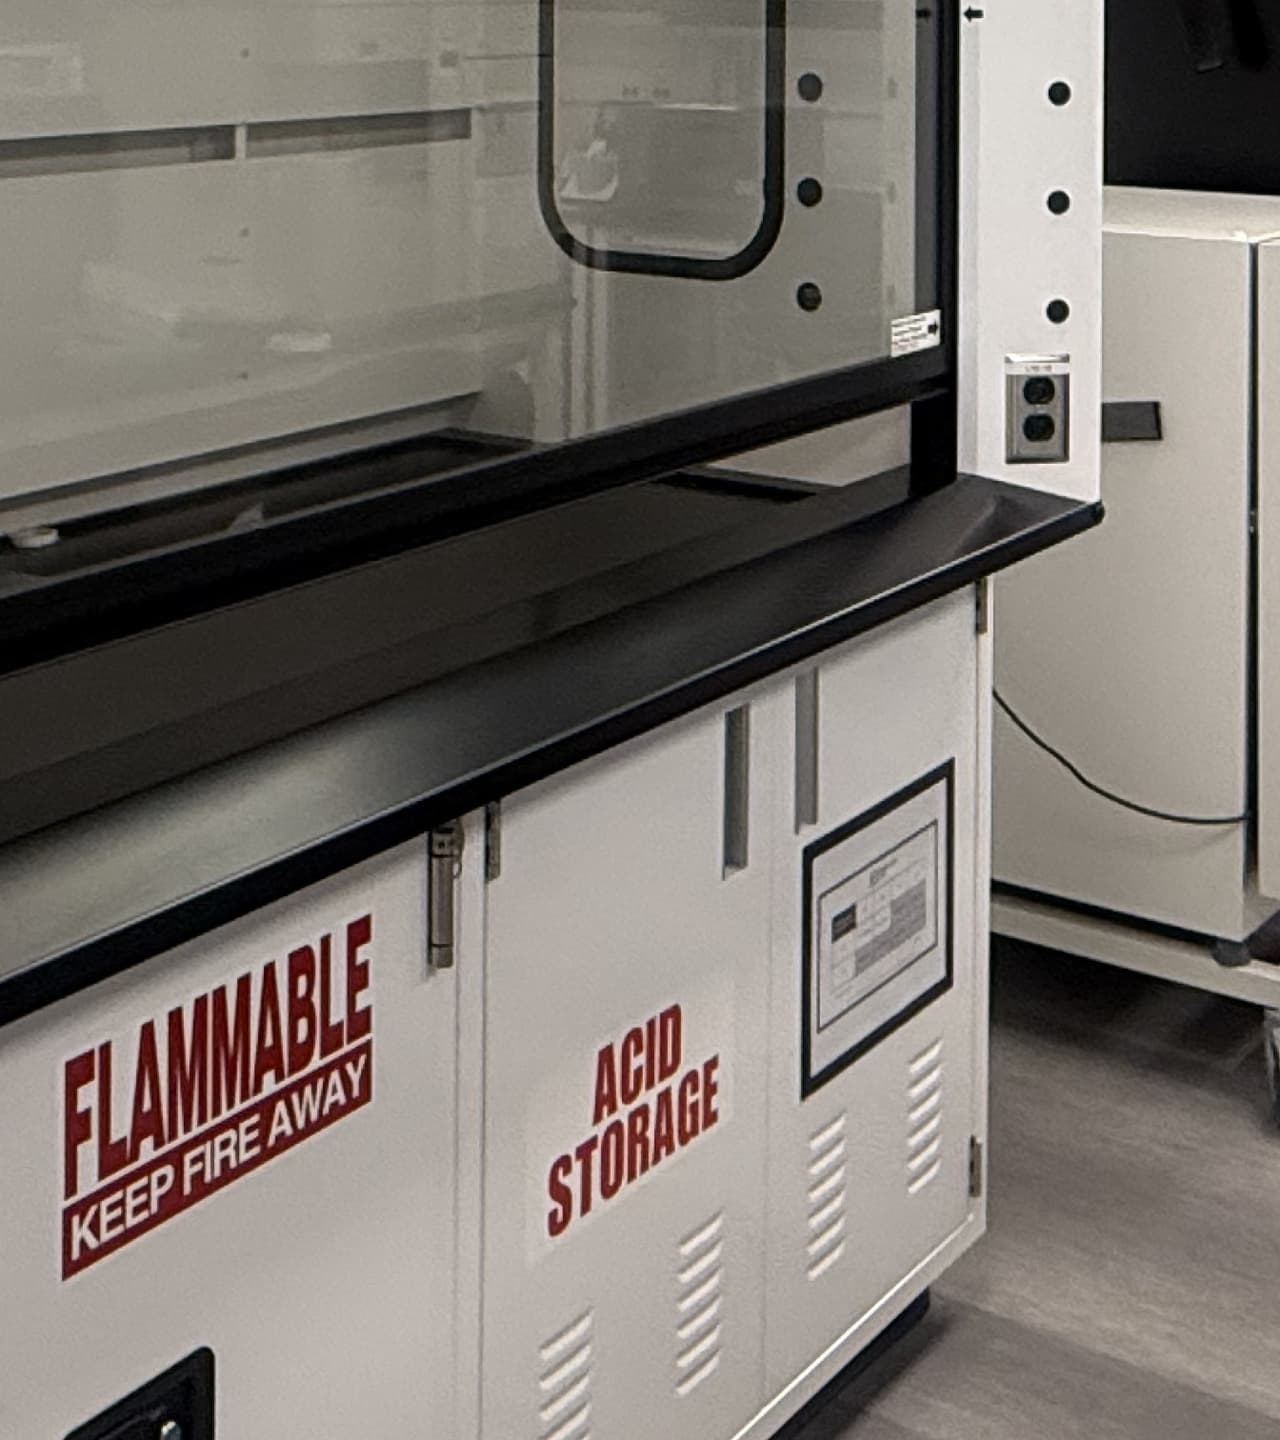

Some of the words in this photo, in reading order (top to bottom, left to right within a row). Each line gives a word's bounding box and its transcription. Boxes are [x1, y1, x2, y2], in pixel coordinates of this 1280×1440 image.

[64, 913, 372, 1201] FLAMMABLE
[547, 1052, 719, 1238] STORAGE
[591, 1002, 682, 1127] ACID
[71, 1163, 174, 1261] KEEP
[182, 1113, 261, 1196] FIRE
[266, 1053, 367, 1148] AWAY
